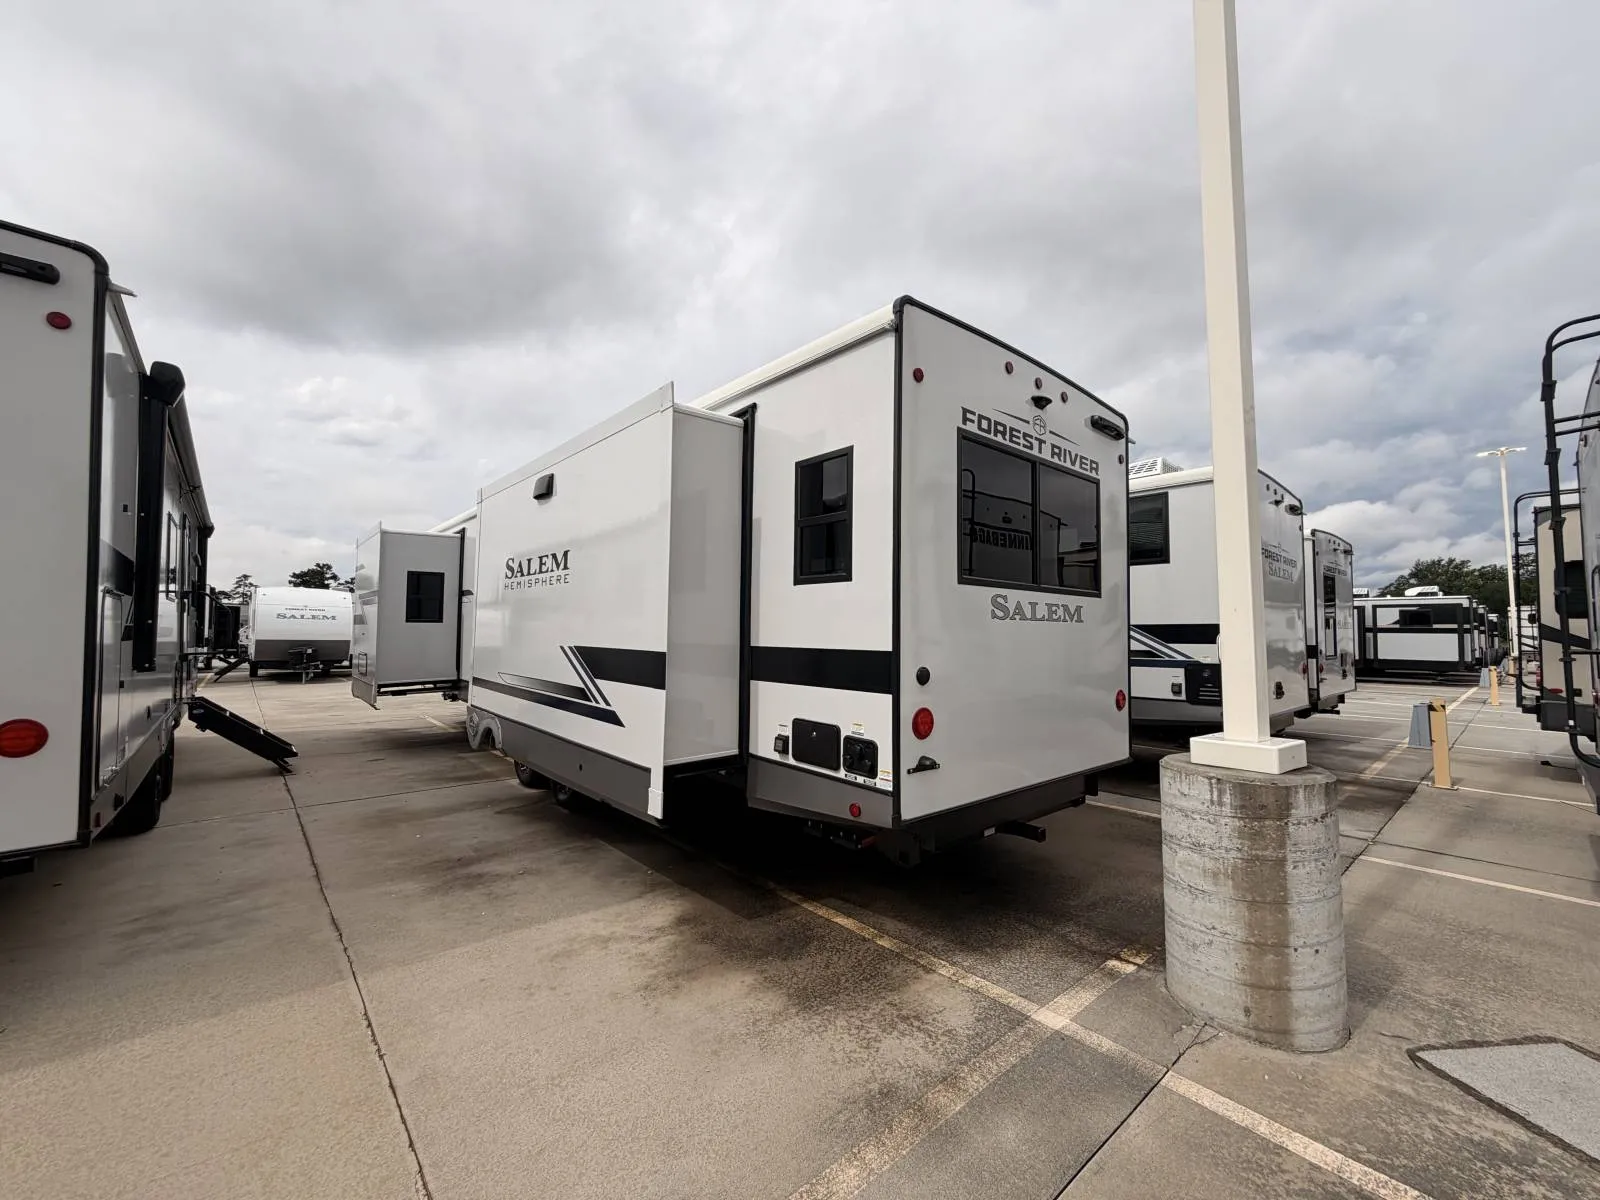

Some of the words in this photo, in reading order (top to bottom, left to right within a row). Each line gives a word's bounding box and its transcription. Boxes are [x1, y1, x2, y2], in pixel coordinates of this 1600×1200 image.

[961, 406, 1046, 455] FOREST
[1050, 442, 1100, 476] RIVER
[505, 549, 571, 579] SALEM
[504, 573, 570, 591] HEMISPHERE
[276, 612, 337, 621] SALEM
[990, 593, 1084, 624] SALEM
